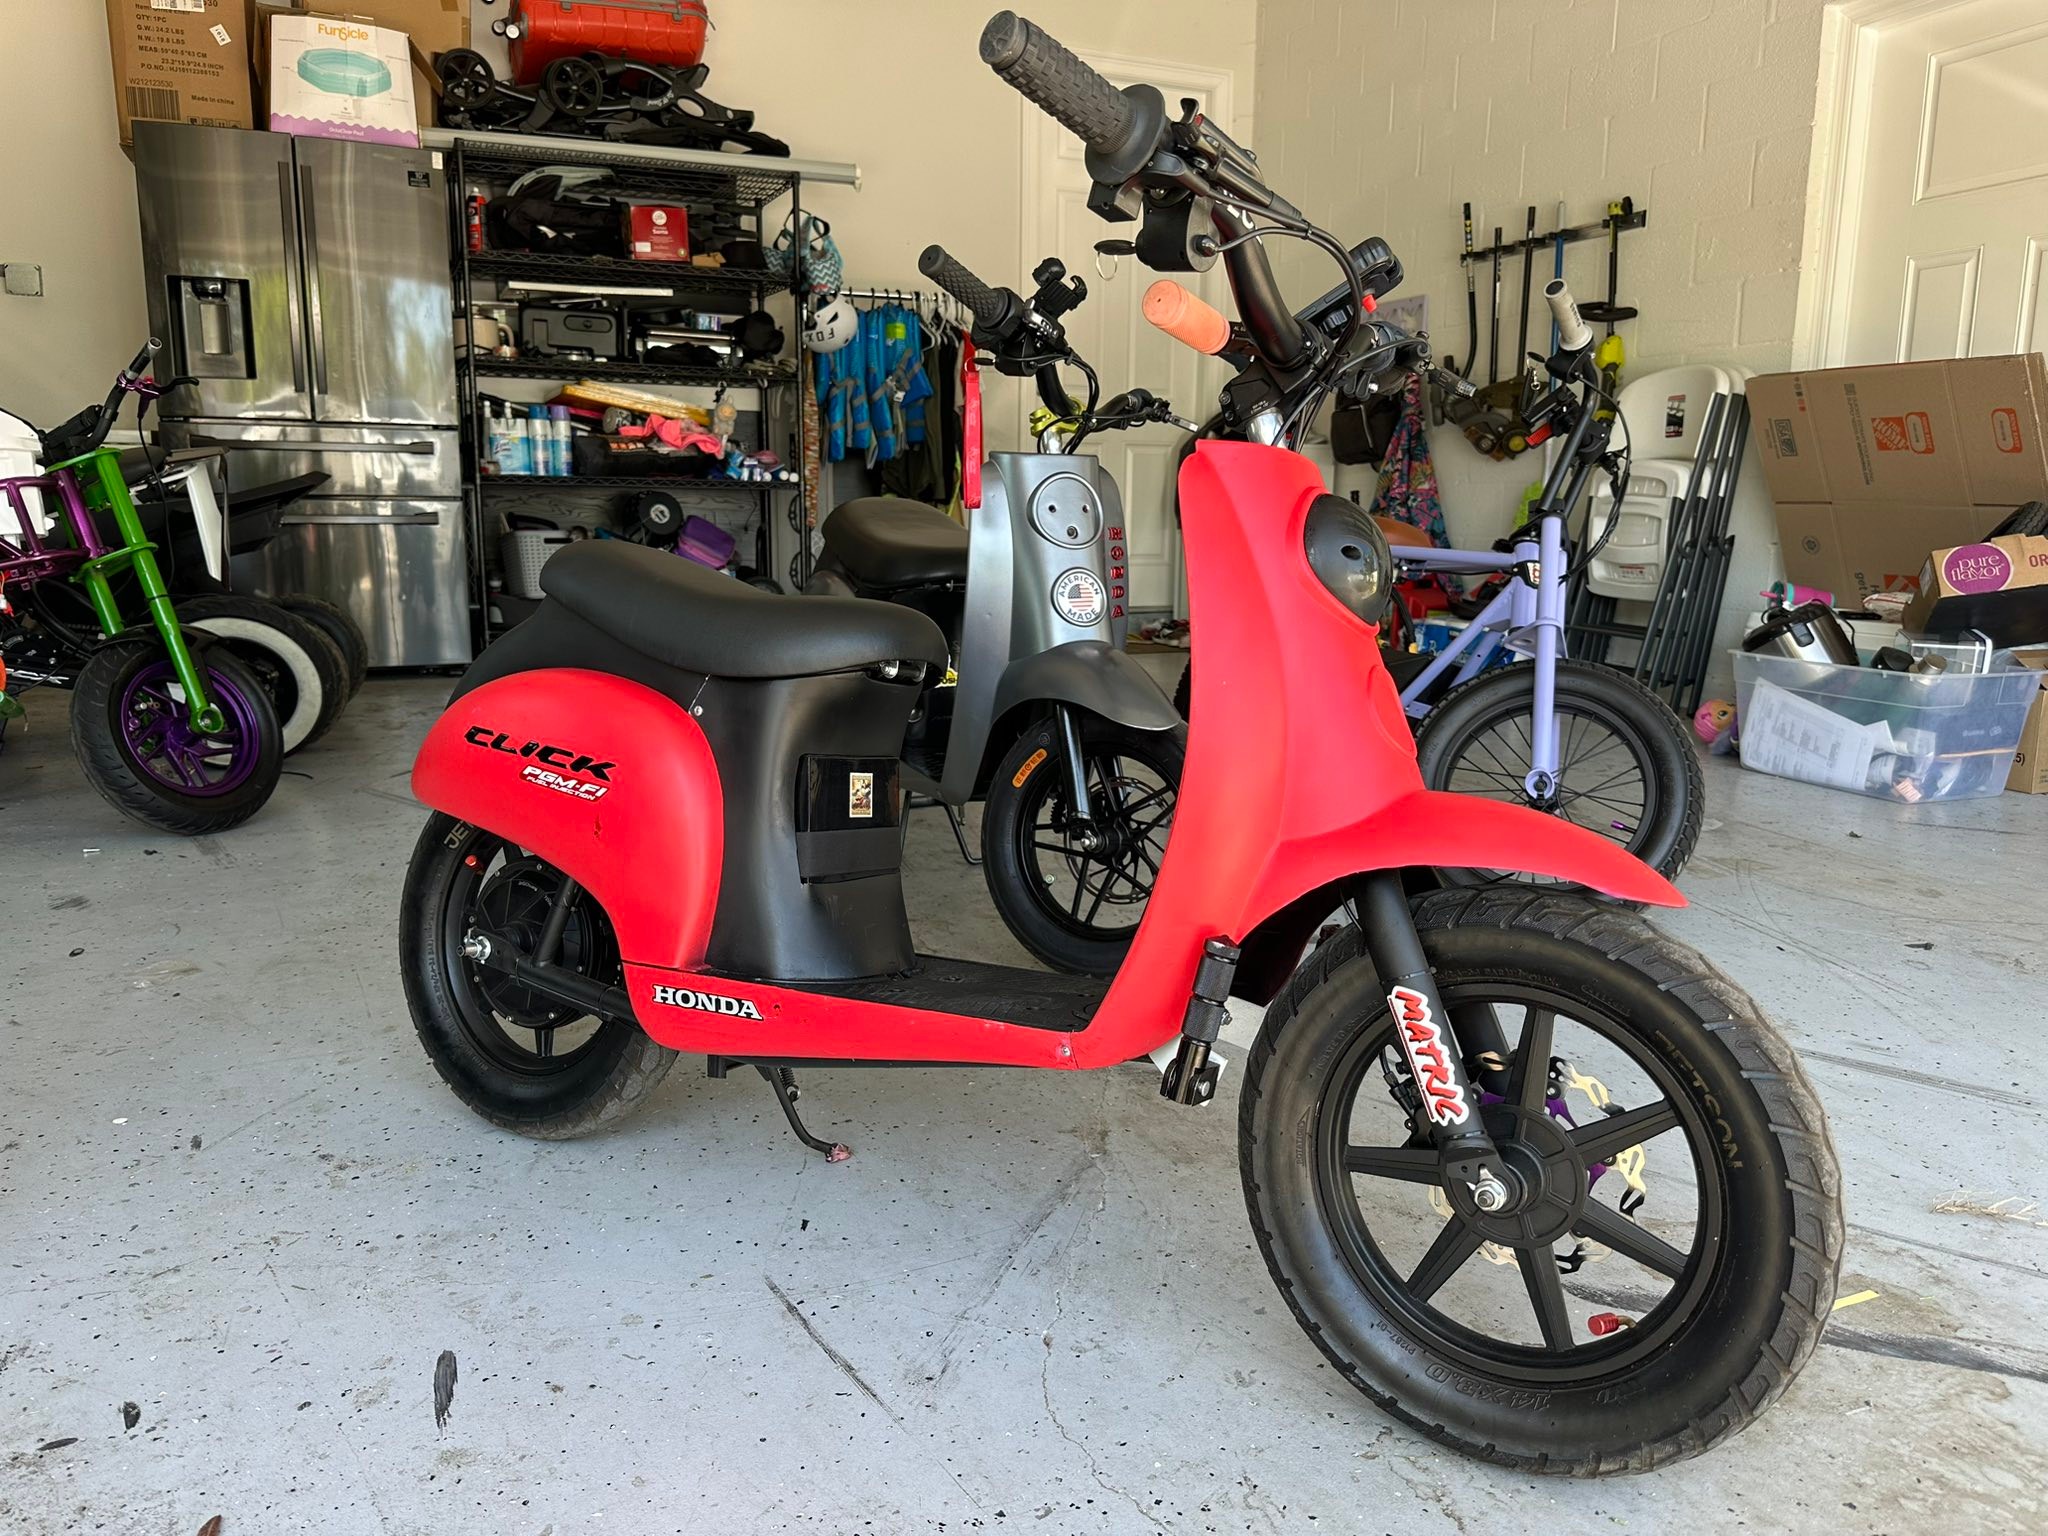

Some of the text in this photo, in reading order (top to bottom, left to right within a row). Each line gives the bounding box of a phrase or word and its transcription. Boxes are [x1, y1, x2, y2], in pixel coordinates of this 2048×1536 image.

[1958, 554, 2001, 571] pure
[1058, 574, 1100, 598] AMERICAN
[1066, 607, 1100, 621] MADE
[464, 725, 617, 782] CLICK
[526, 775, 596, 801] FUEL INJECTION
[653, 984, 764, 1021] HONDA
[1394, 990, 1464, 1121] MATRIC
